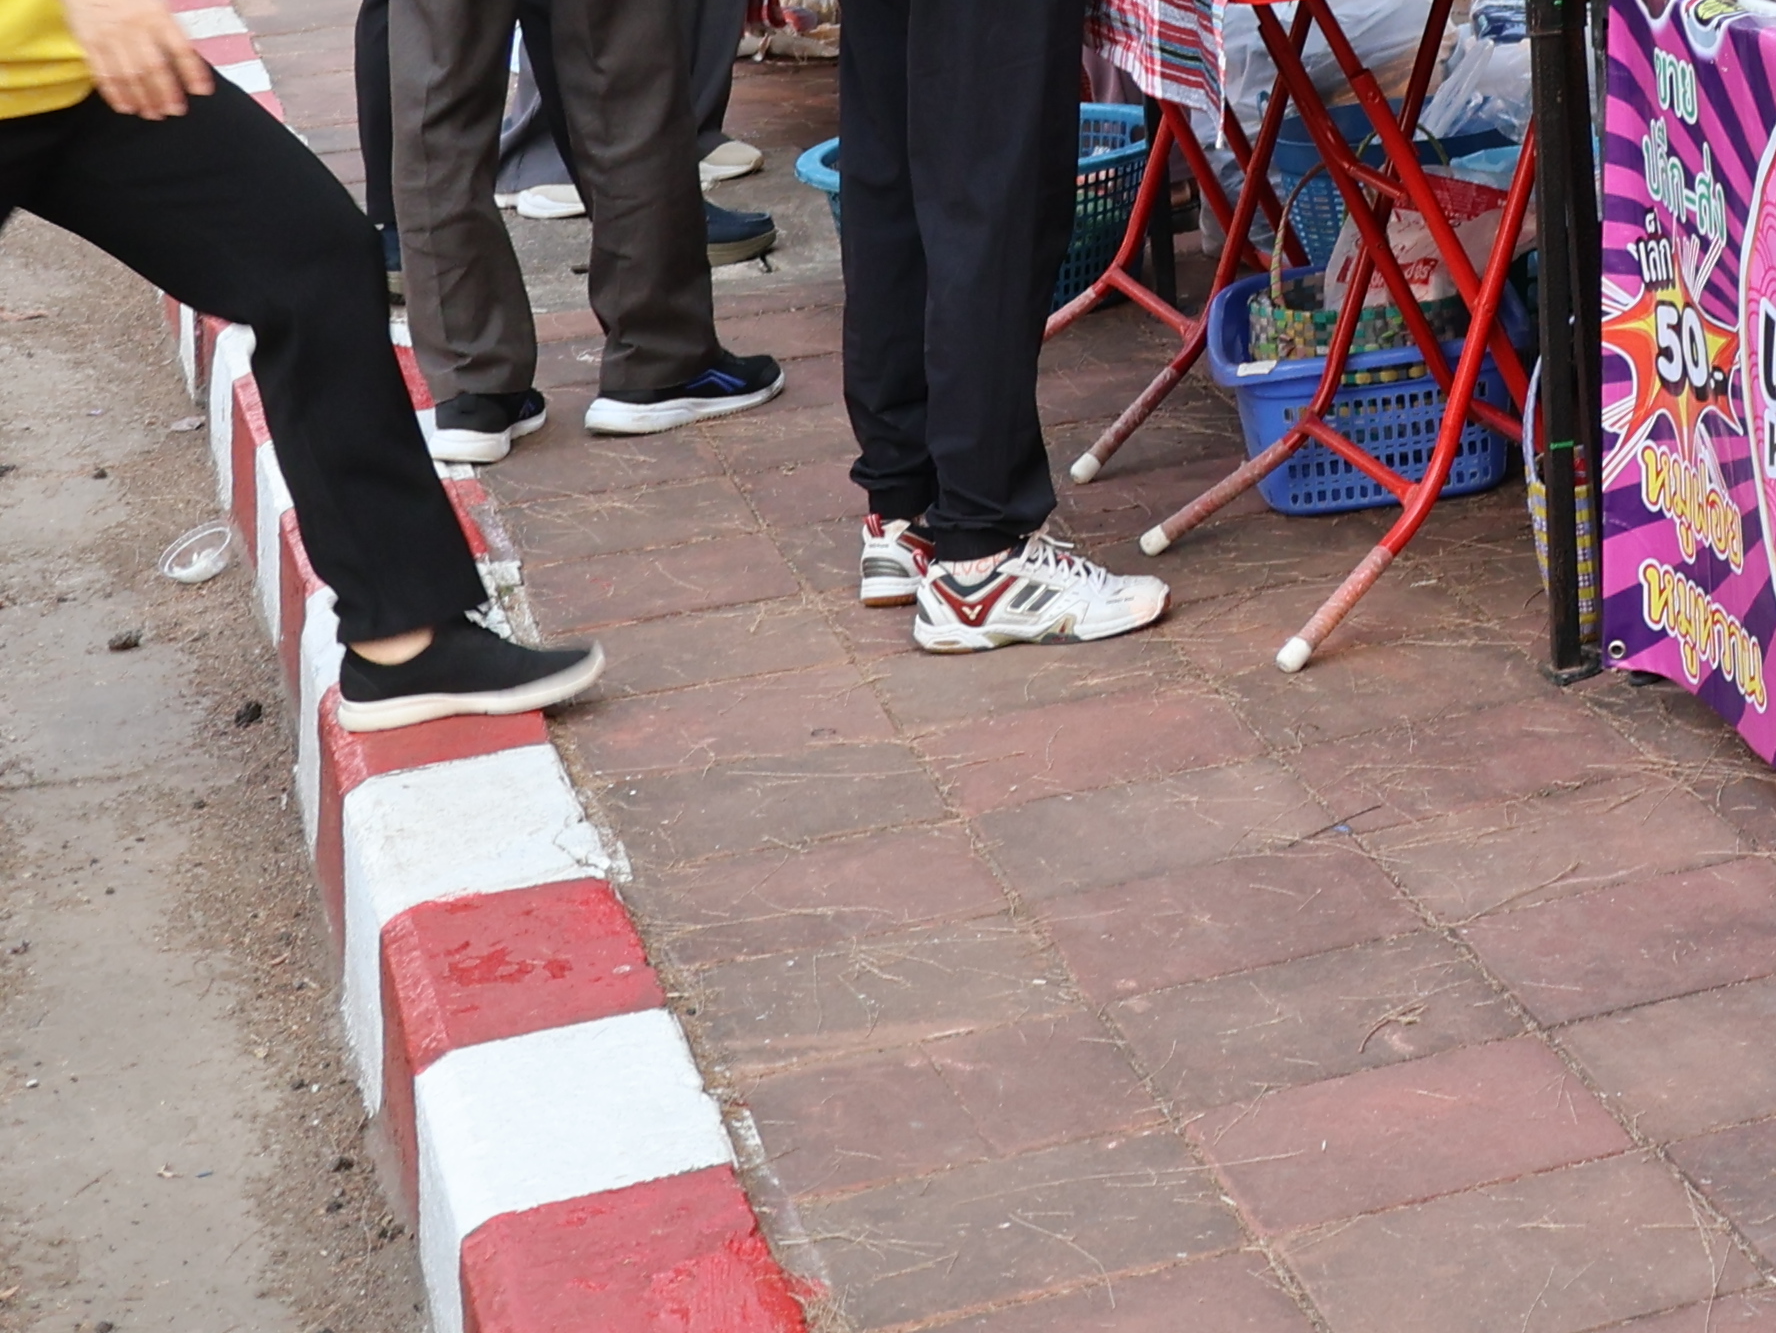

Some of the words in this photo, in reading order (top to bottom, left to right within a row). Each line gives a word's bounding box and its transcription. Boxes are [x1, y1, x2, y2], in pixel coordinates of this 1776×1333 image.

[1654, 48, 1697, 124] ขาย
[1643, 117, 1726, 247] ปลีก-ส่ง
[1639, 210, 1674, 283] เล็ก
[1656, 305, 1726, 392] 50.-
[1640, 441, 1744, 576] หมูฝอย
[1639, 559, 1766, 713] หมูหวาน
